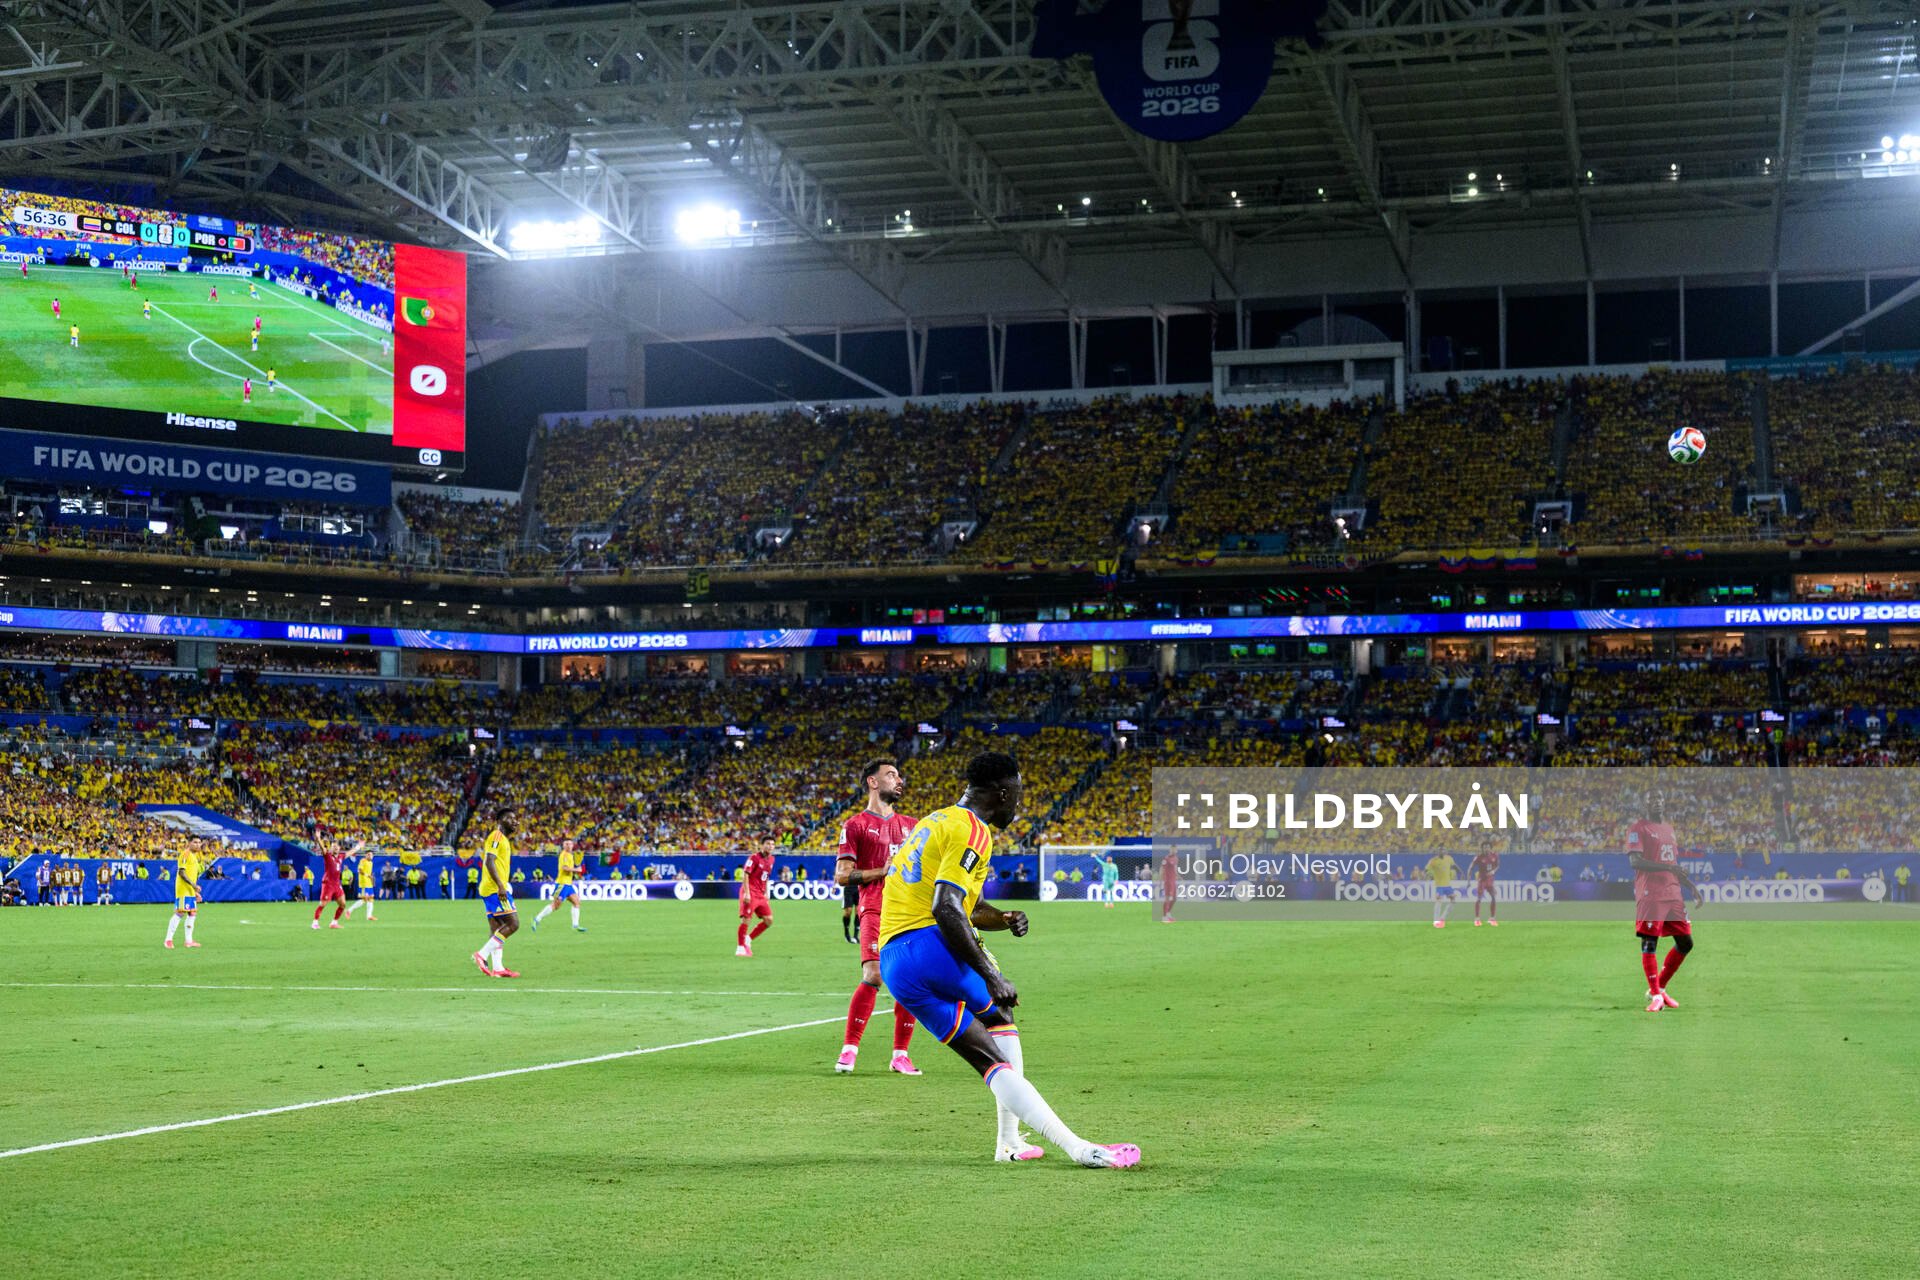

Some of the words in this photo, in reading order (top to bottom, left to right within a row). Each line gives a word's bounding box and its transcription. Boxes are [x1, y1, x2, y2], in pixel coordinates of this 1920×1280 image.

[1164, 55, 1200, 71] FIFA
[1143, 84, 1191, 98] WORLD
[1193, 83, 1220, 95] CUP
[1142, 97, 1220, 117] 2026
[23, 209, 67, 226] 56:36
[115, 221, 136, 235] COL
[145, 226, 154, 238] 0
[178, 231, 187, 243] 0
[194, 233, 216, 246] POR
[166, 411, 237, 431] Hisense
[421, 452, 438, 463] CC
[34, 446, 94, 470] FIFA
[100, 453, 201, 479] WORLD
[207, 461, 260, 485] CUP
[265, 467, 357, 493] 2026
[1465, 614, 1521, 629] MIAMI
[1725, 608, 1762, 623] FIFA
[1762, 607, 1825, 622] WORLD
[1826, 606, 1861, 621] CUP
[1863, 604, 1920, 620] 2026
[287, 625, 343, 641] MIAMI
[861, 629, 912, 642] MIAMI
[529, 637, 558, 651] FIFA
[559, 636, 608, 650] WORLD
[610, 635, 638, 649] CUP
[639, 634, 688, 648] 2026
[1660, 844, 1675, 862] 25
[111, 862, 134, 876] FIFA
[1680, 861, 1714, 875] FIFA
[540, 880, 648, 901] mtorola
[1697, 880, 1824, 903] motorola
